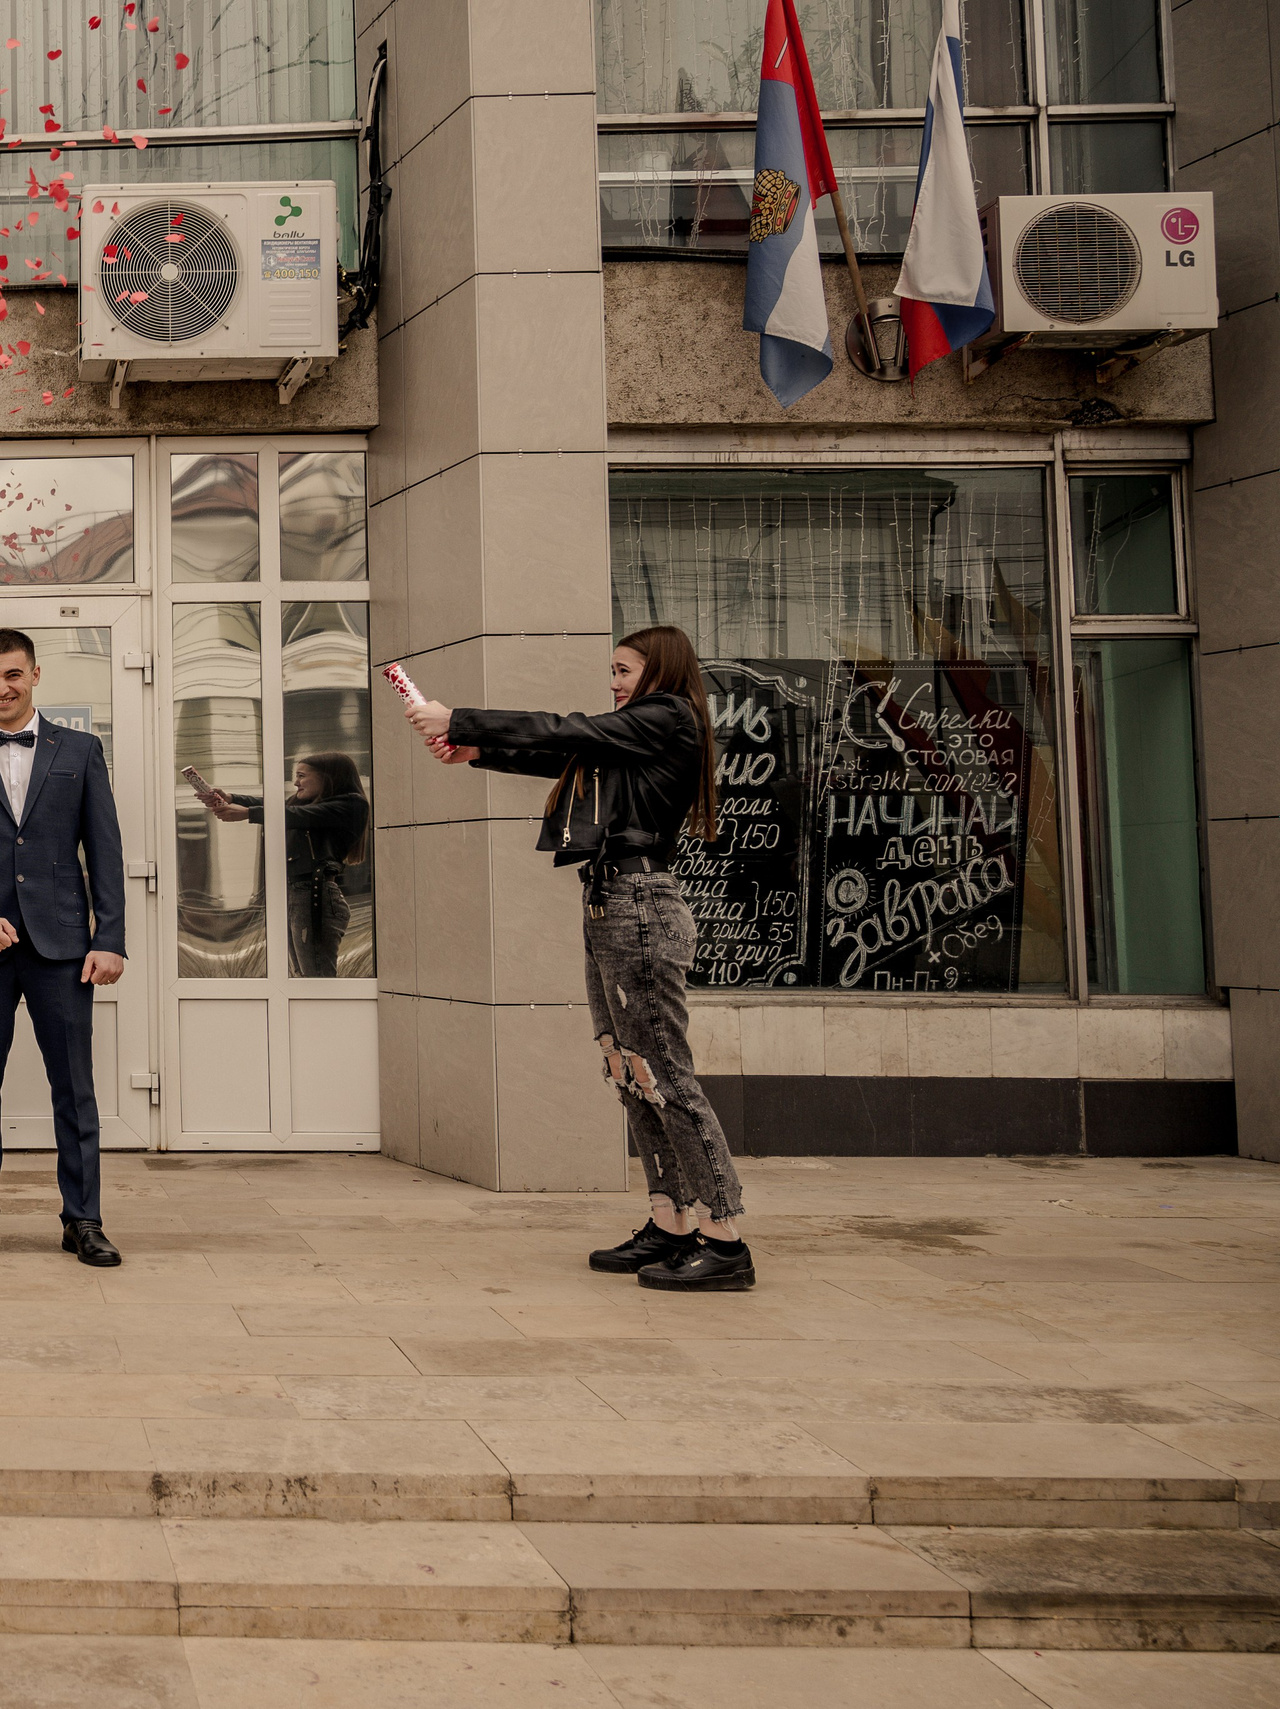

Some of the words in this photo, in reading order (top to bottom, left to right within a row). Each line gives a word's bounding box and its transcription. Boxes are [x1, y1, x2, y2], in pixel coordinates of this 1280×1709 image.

[1165, 250, 1195, 267] LG
[273, 269, 319, 279] 400-150
[898, 682, 1012, 741] Стрелки
[47, 717, 85, 731] ОД
[904, 749, 1014, 766] СТОЛОВАЯ
[739, 823, 780, 850] 150
[767, 921, 795, 942] 55
[707, 961, 741, 985] 110
